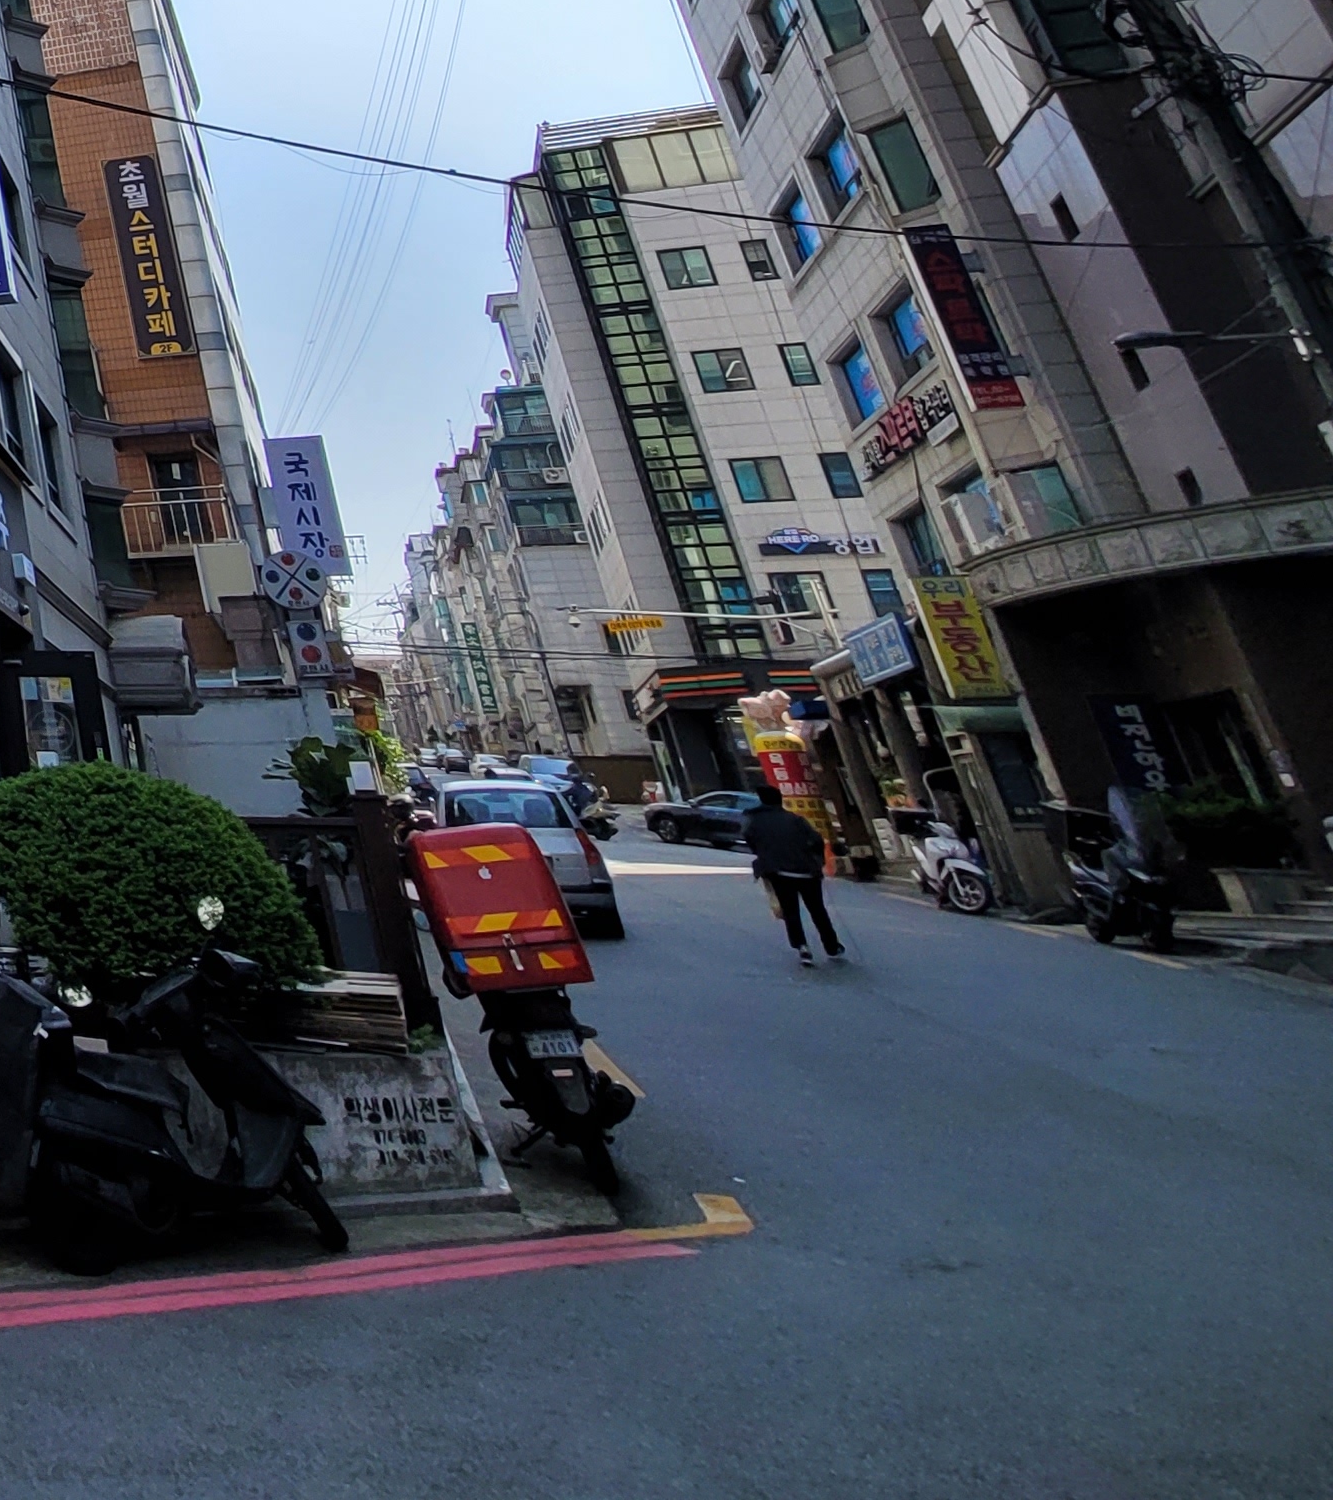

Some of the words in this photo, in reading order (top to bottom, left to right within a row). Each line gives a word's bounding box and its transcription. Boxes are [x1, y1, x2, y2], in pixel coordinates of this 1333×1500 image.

[159, 343, 175, 354] 2F
[283, 452, 331, 558] 국제시장
[921, 578, 967, 600] 우리
[930, 598, 995, 684] 부동산
